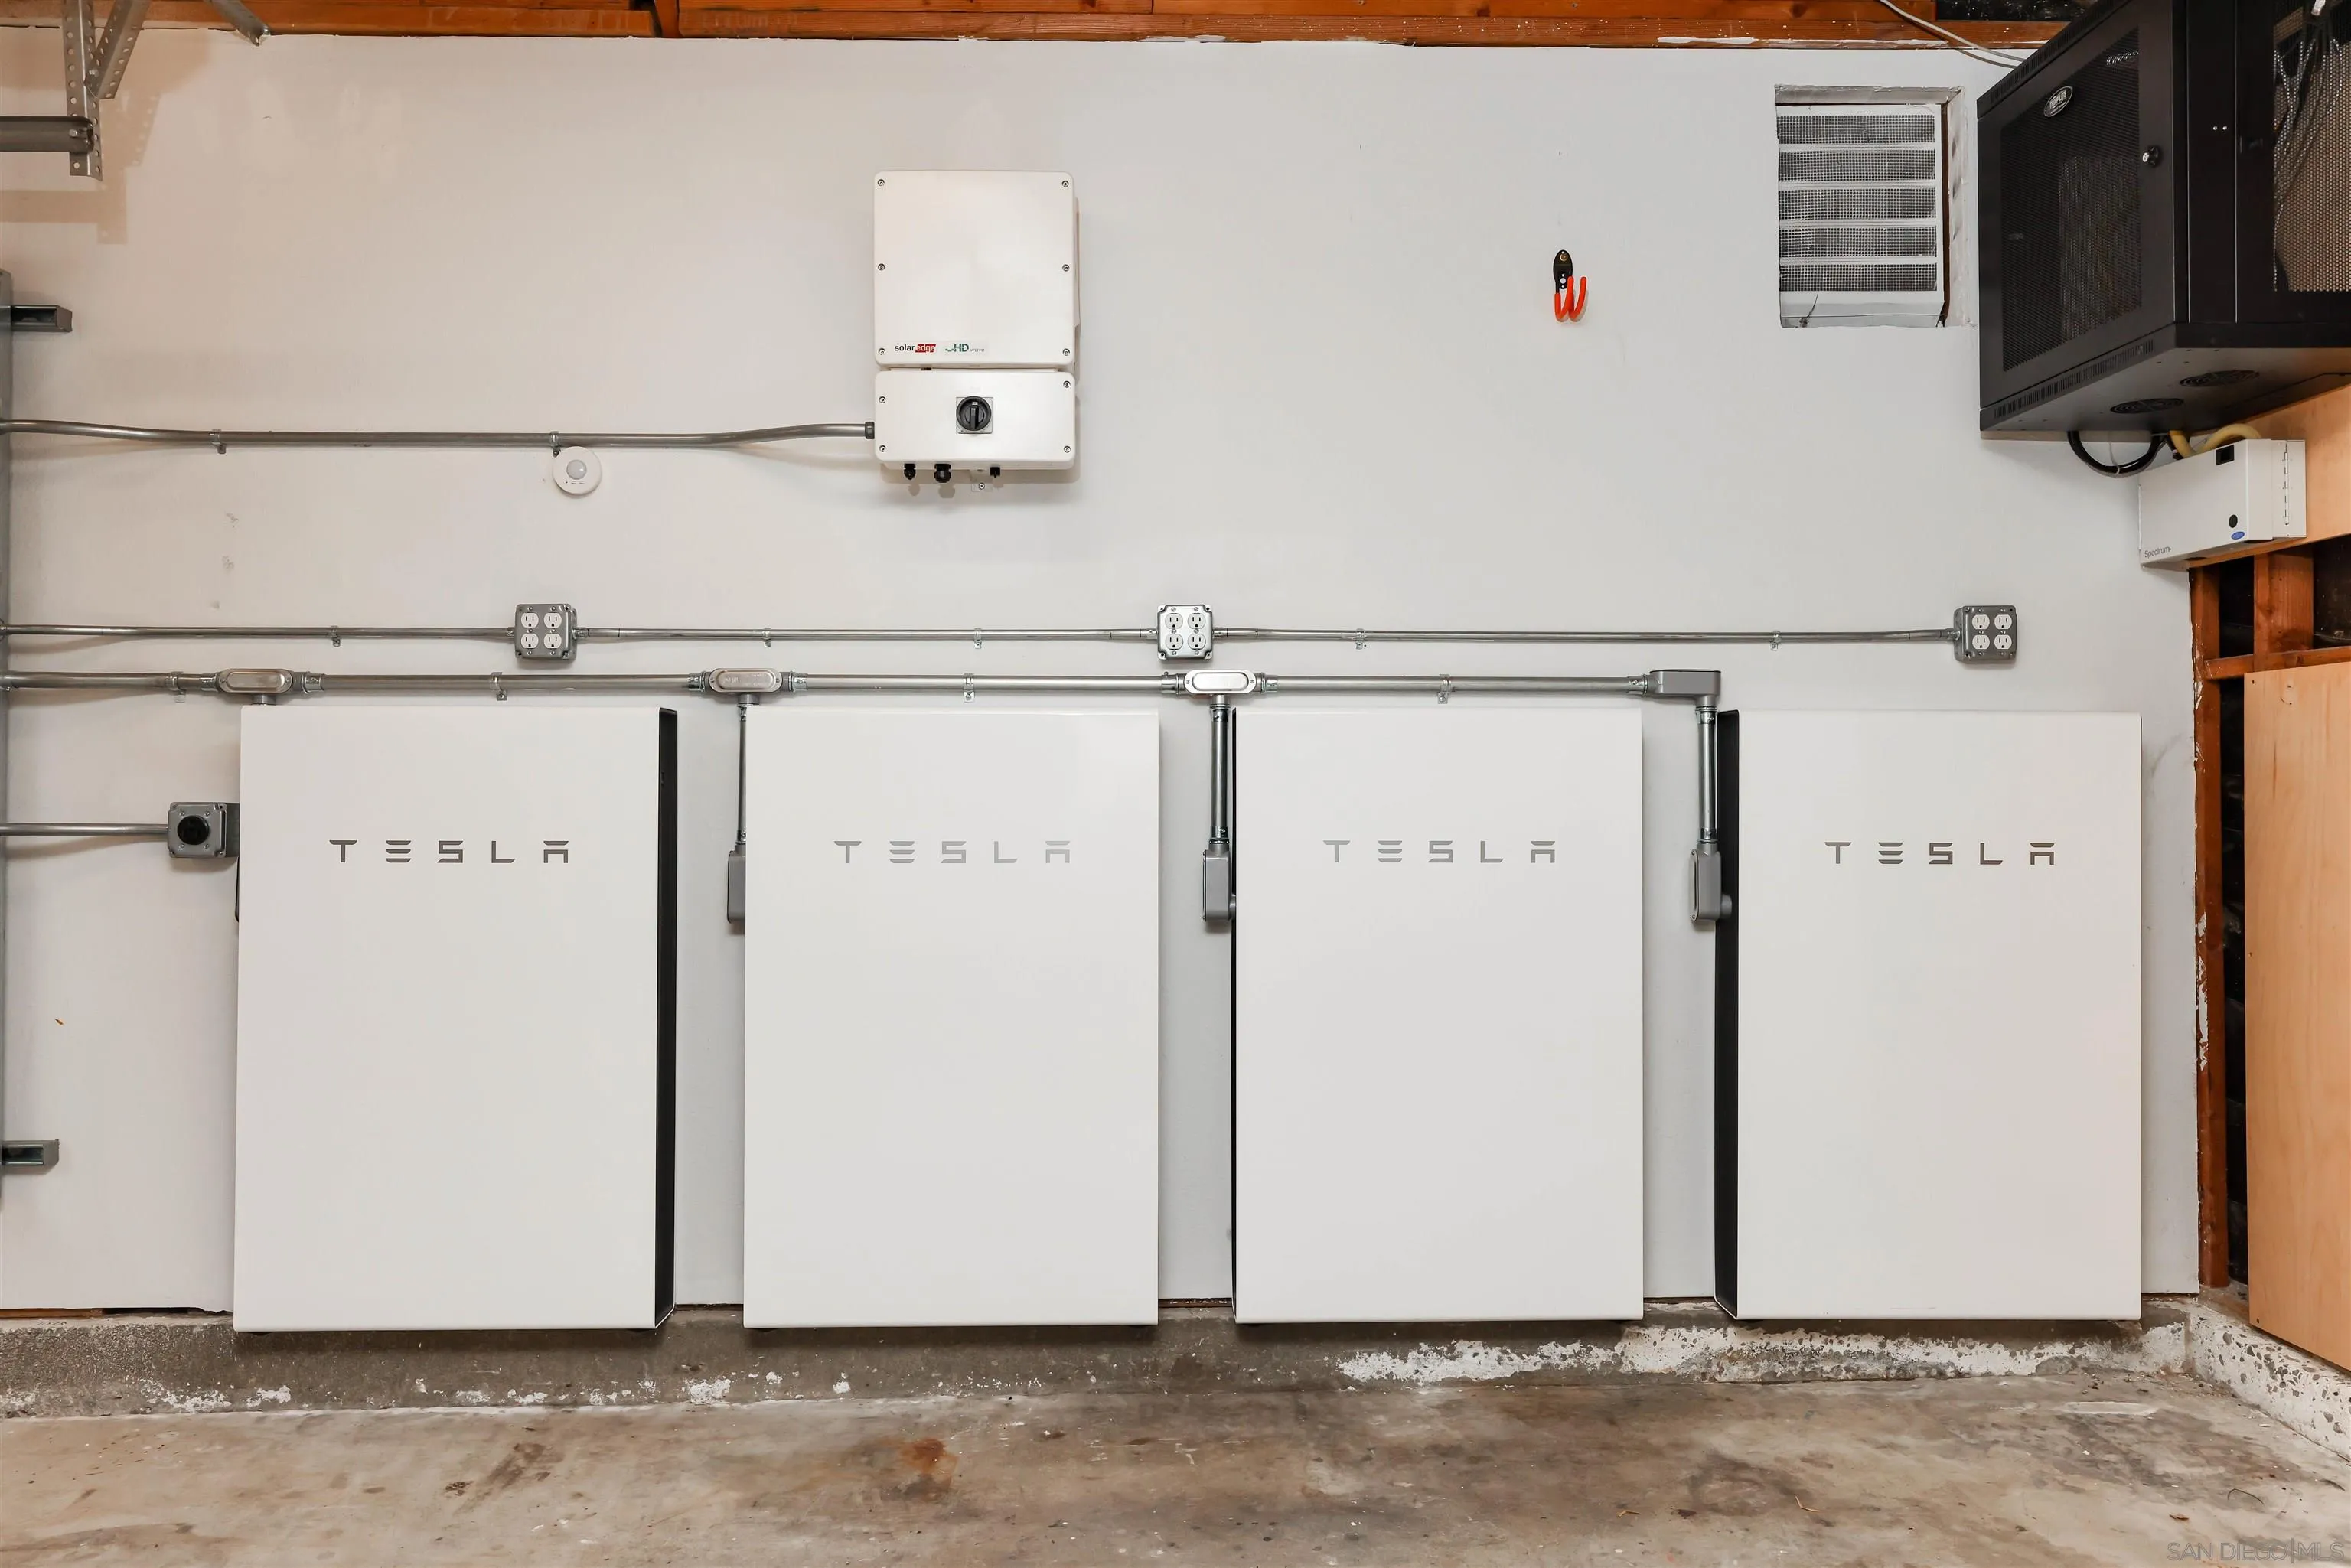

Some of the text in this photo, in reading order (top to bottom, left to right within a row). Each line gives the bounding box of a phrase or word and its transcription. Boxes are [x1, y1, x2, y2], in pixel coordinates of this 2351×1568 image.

[894, 344, 936, 353] solaredge
[954, 344, 969, 352] HD
[329, 839, 569, 863] TESLA
[833, 840, 1070, 863] TESLA
[1323, 840, 1555, 863] TESLA
[1824, 841, 2055, 865] TESLA
